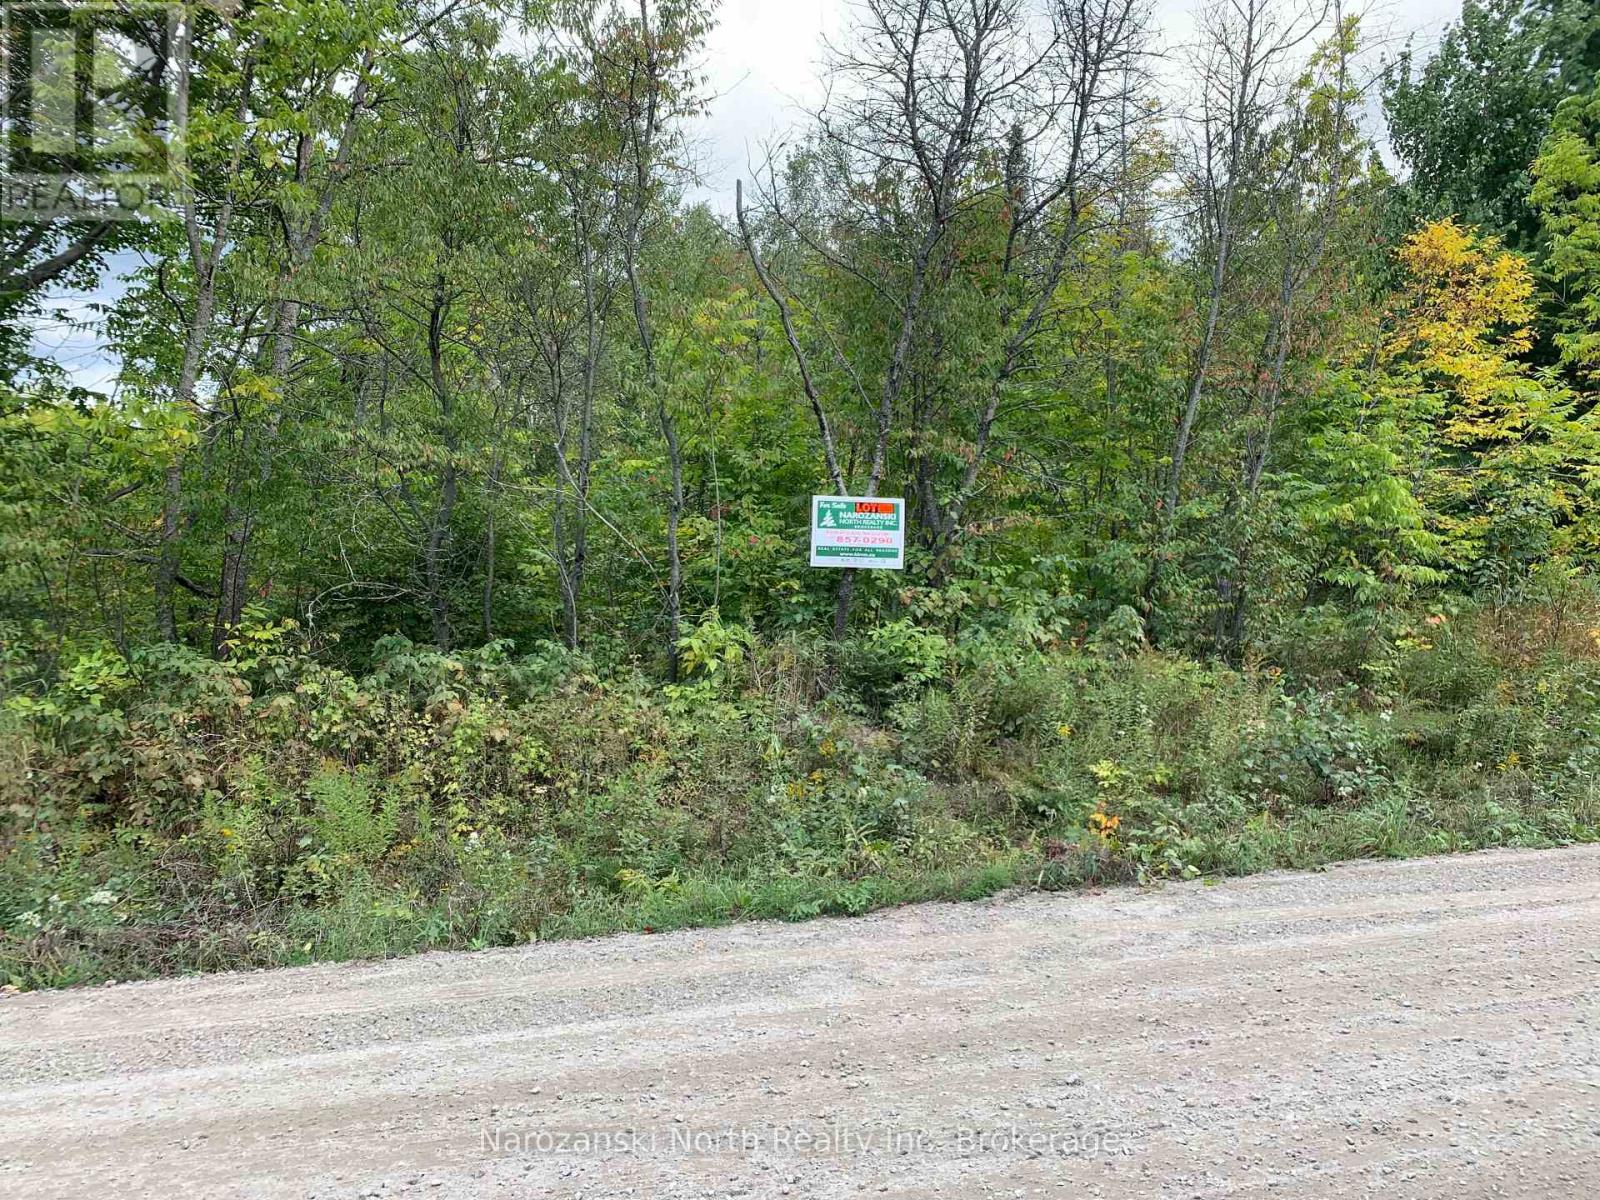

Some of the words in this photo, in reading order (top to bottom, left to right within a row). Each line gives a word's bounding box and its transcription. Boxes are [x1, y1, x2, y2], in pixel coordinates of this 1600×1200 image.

[857, 503, 878, 512] LOT
[839, 512, 897, 520] NAROZANSKI
[837, 536, 893, 544] 857-0290
